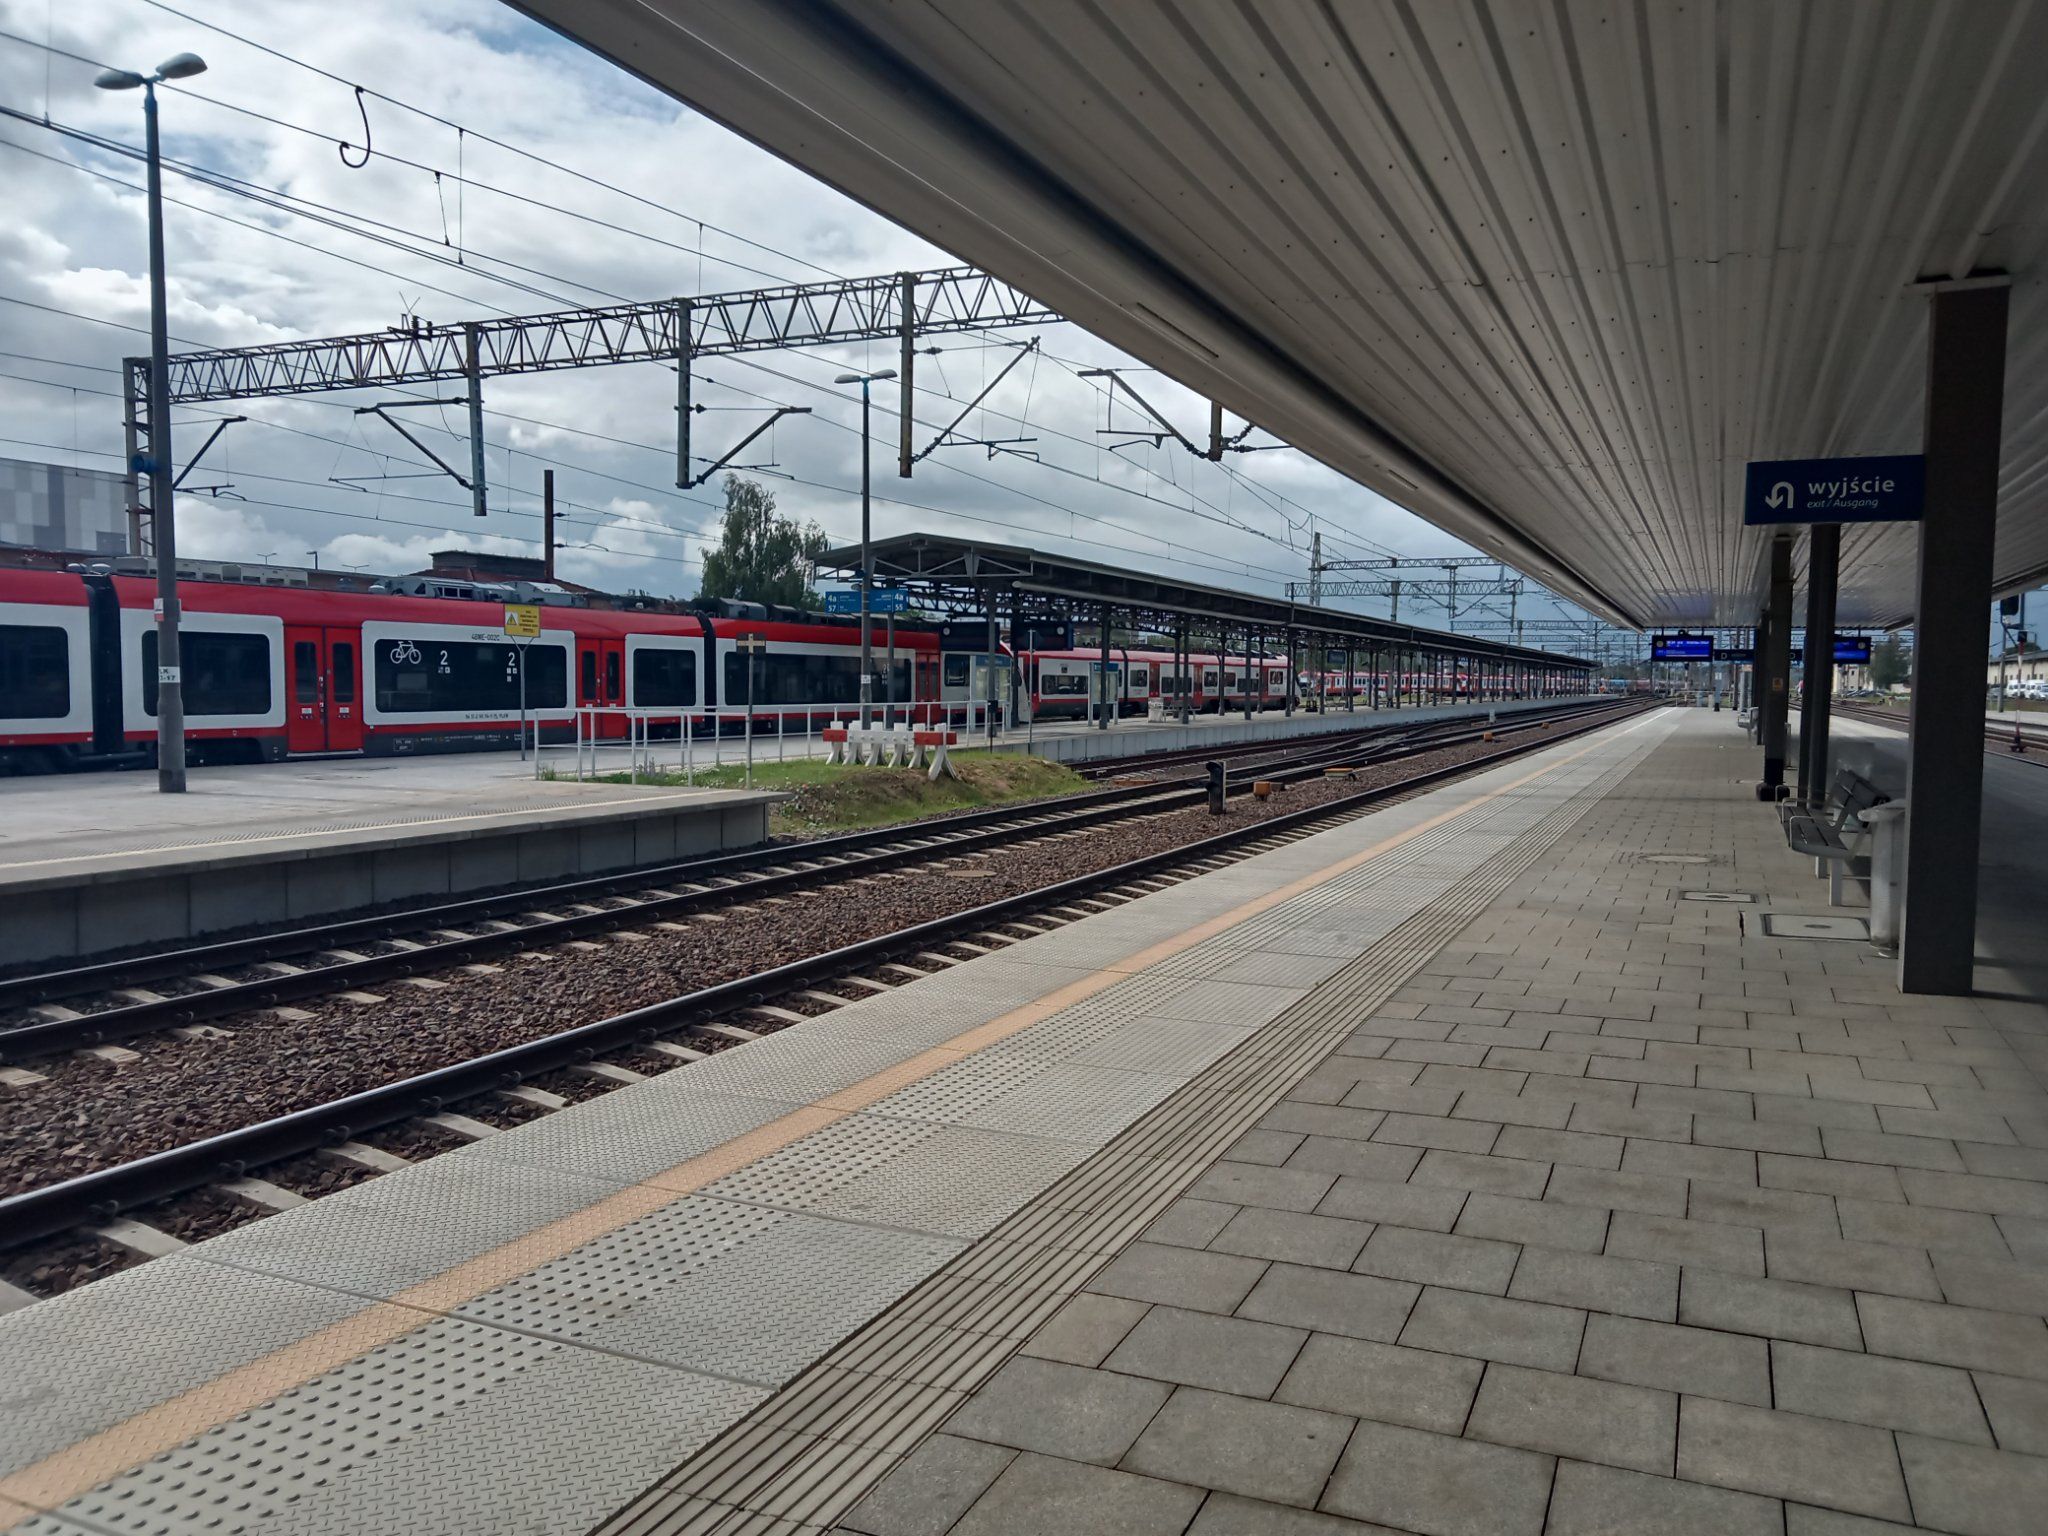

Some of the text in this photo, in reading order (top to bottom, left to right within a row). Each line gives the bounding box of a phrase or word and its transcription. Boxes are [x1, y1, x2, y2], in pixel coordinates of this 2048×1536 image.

[1808, 476, 1895, 498] wyjście
[1807, 500, 1826, 508] exit
[1833, 499, 1879, 509] Ausgang
[440, 650, 448, 665] 2
[508, 652, 516, 666] 2
